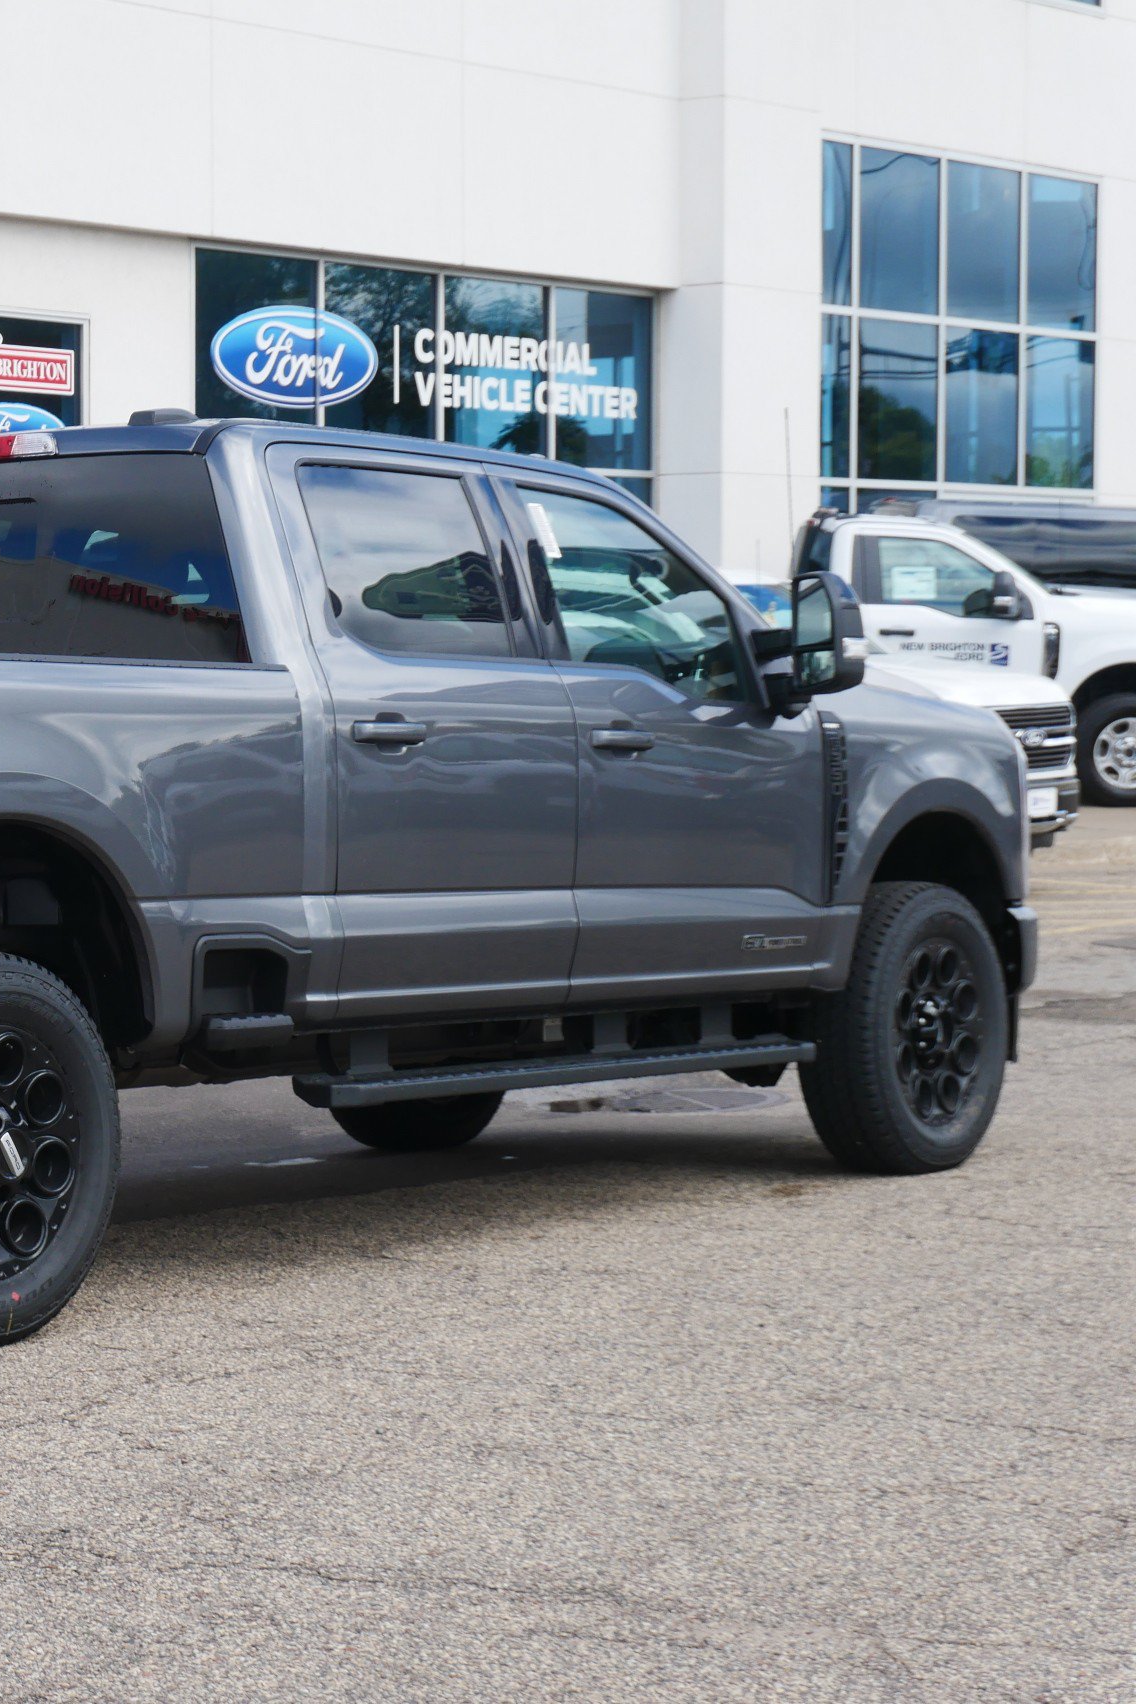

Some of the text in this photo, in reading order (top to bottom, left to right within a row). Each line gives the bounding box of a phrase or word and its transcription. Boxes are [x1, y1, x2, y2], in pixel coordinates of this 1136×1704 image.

[245, 320, 346, 390] Ford
[414, 328, 598, 376] COMMERCIAL
[414, 371, 638, 420] VEHICLE CENTER
